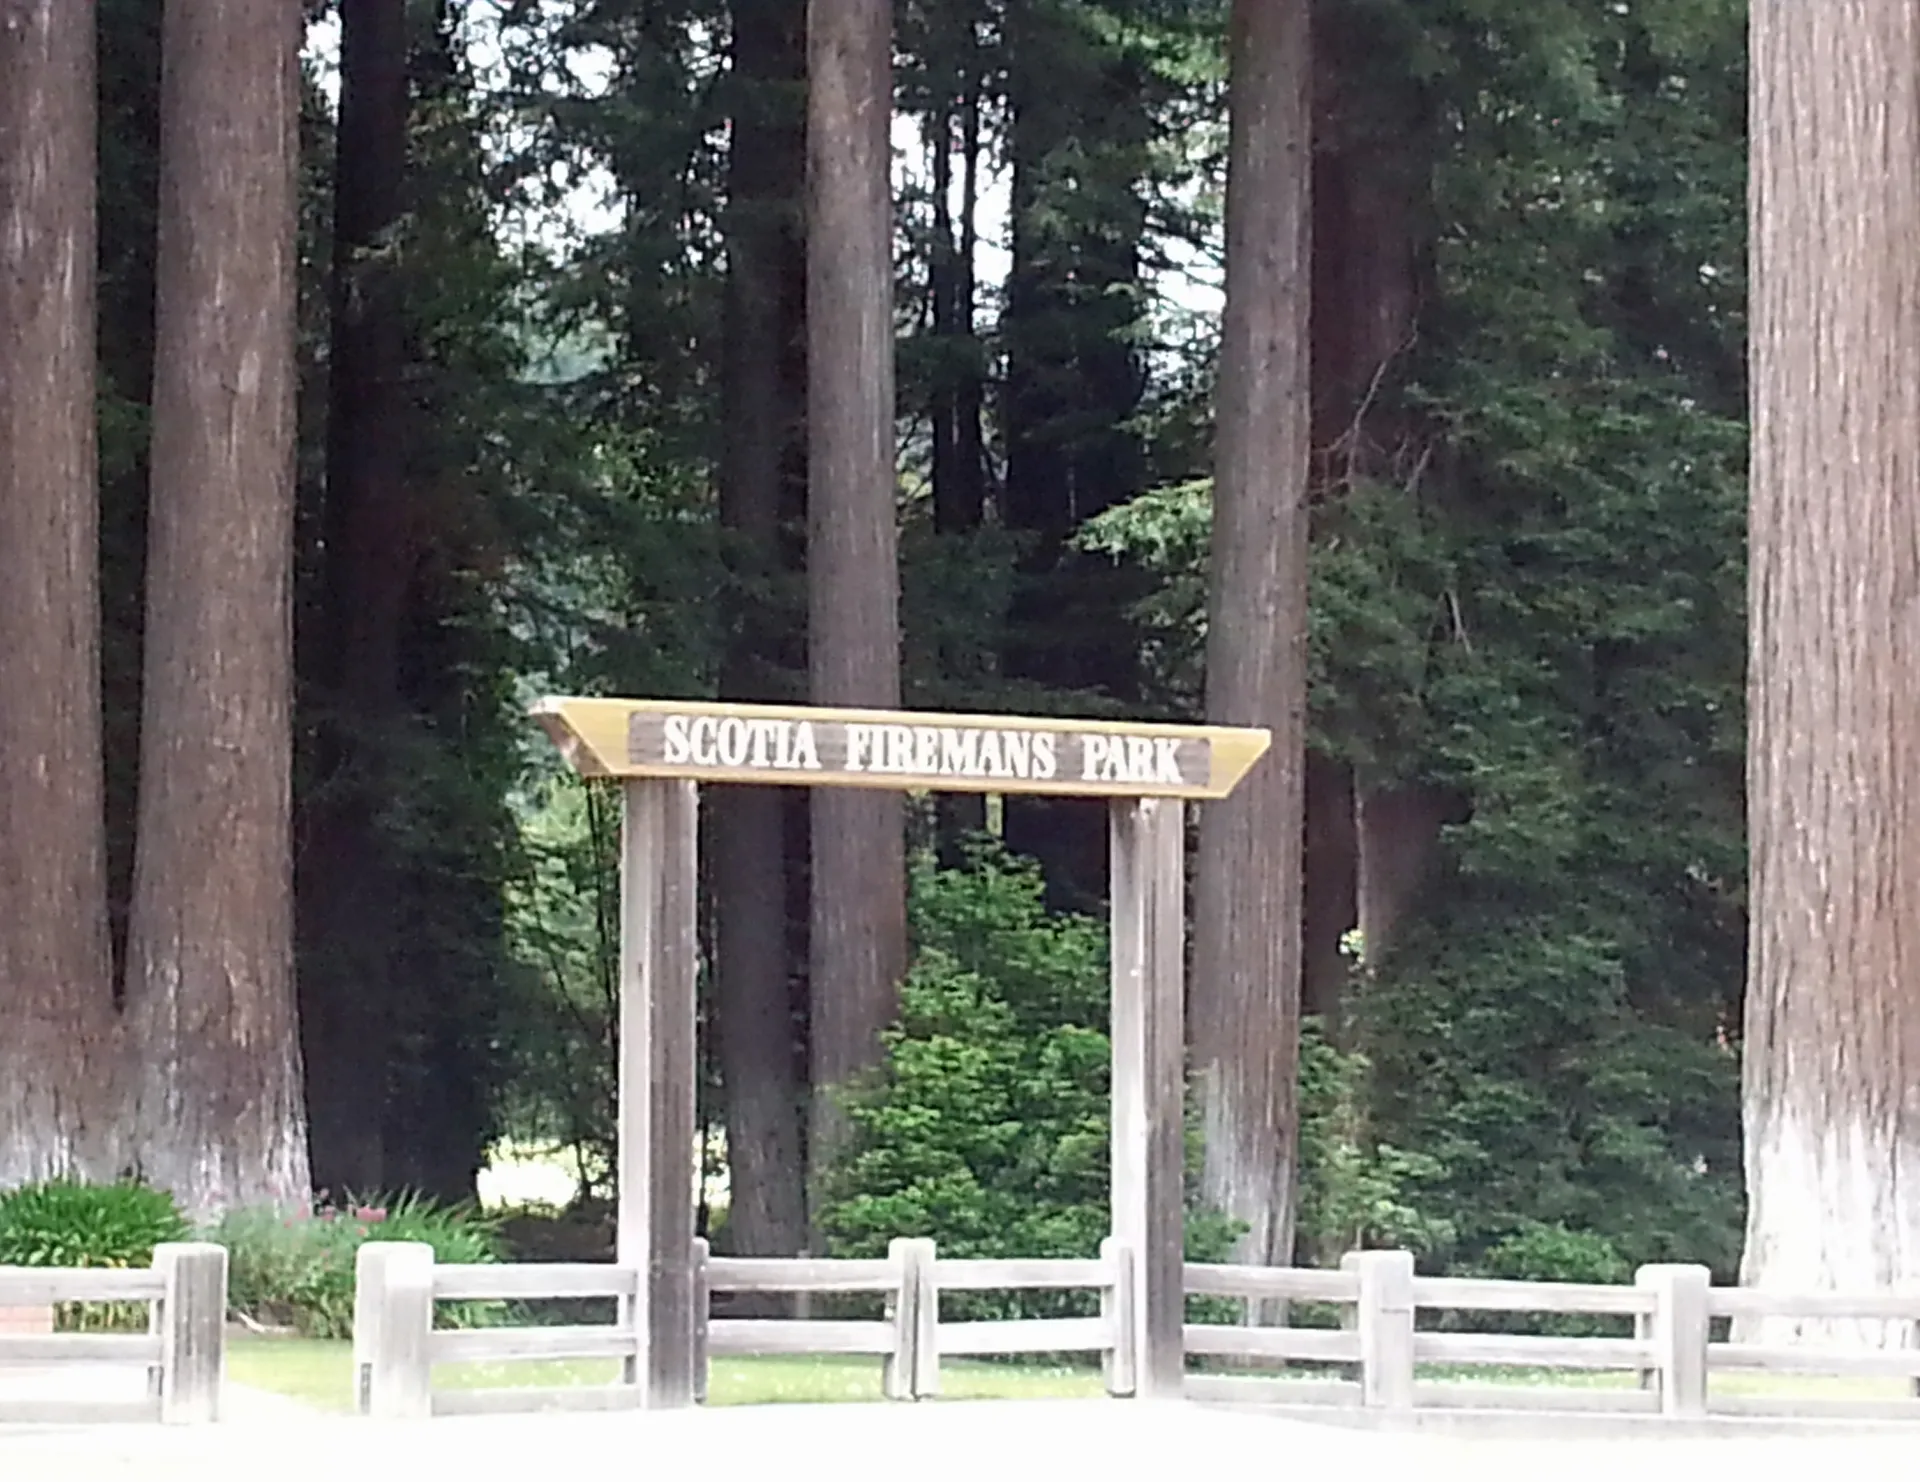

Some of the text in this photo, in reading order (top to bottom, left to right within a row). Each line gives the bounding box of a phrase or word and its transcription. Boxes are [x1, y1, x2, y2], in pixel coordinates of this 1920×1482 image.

[663, 716, 1183, 784] SCOTIA FIREMANS PARK
